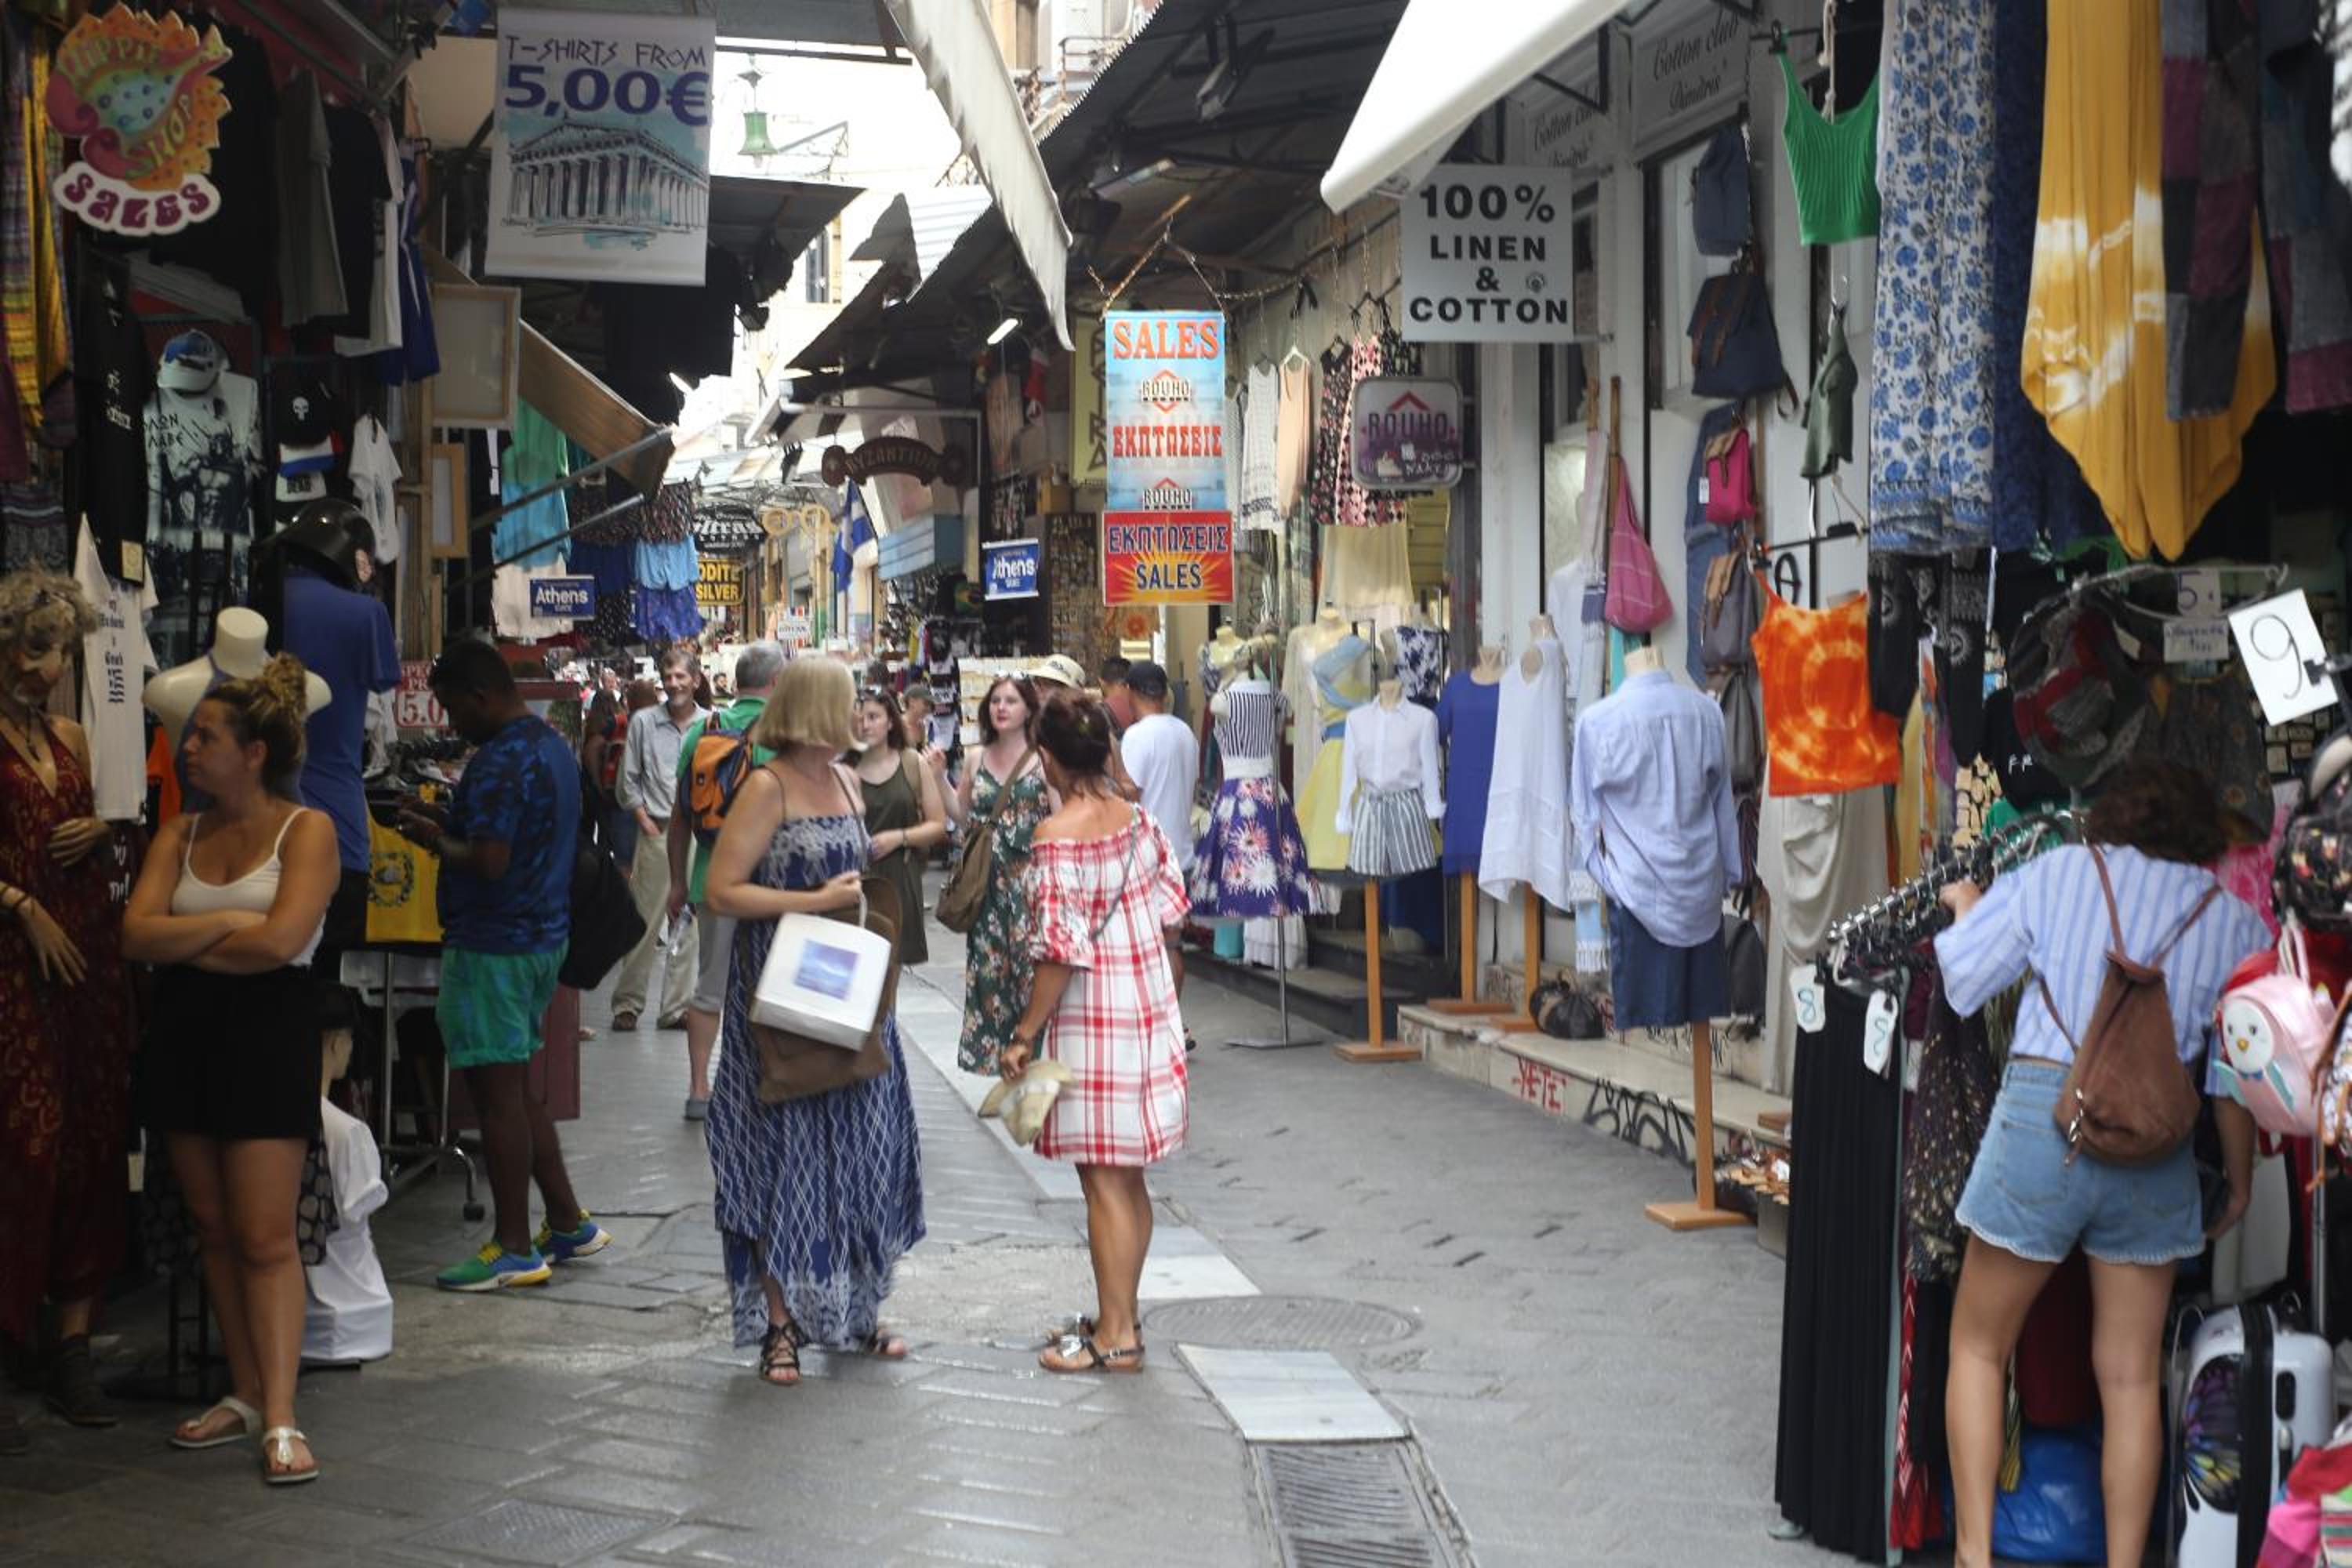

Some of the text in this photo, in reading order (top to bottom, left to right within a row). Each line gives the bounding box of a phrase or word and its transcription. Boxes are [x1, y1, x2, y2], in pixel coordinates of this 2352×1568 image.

[506, 34, 706, 70] T-SHIRTS FROM
[504, 64, 710, 126] 5,00€
[1419, 183, 1555, 223] 100%
[1430, 234, 1546, 262] LINEN
[1475, 266, 1501, 292] &
[1409, 296, 1568, 324] COTTON
[1112, 320, 1220, 361] SALES
[1368, 412, 1448, 439] ROUHO
[1112, 425, 1223, 458] ΕΚΠΤΩΣΕΙΣ
[1108, 524, 1229, 554] ΕΚΠΤΩΣΕΙΣ
[699, 563, 741, 583] ODITE
[1136, 563, 1203, 590] SALES
[535, 585, 589, 604] Athens
[695, 583, 740, 601] SILVER
[2249, 613, 2303, 700] 9
[402, 692, 445, 725] 5.0
